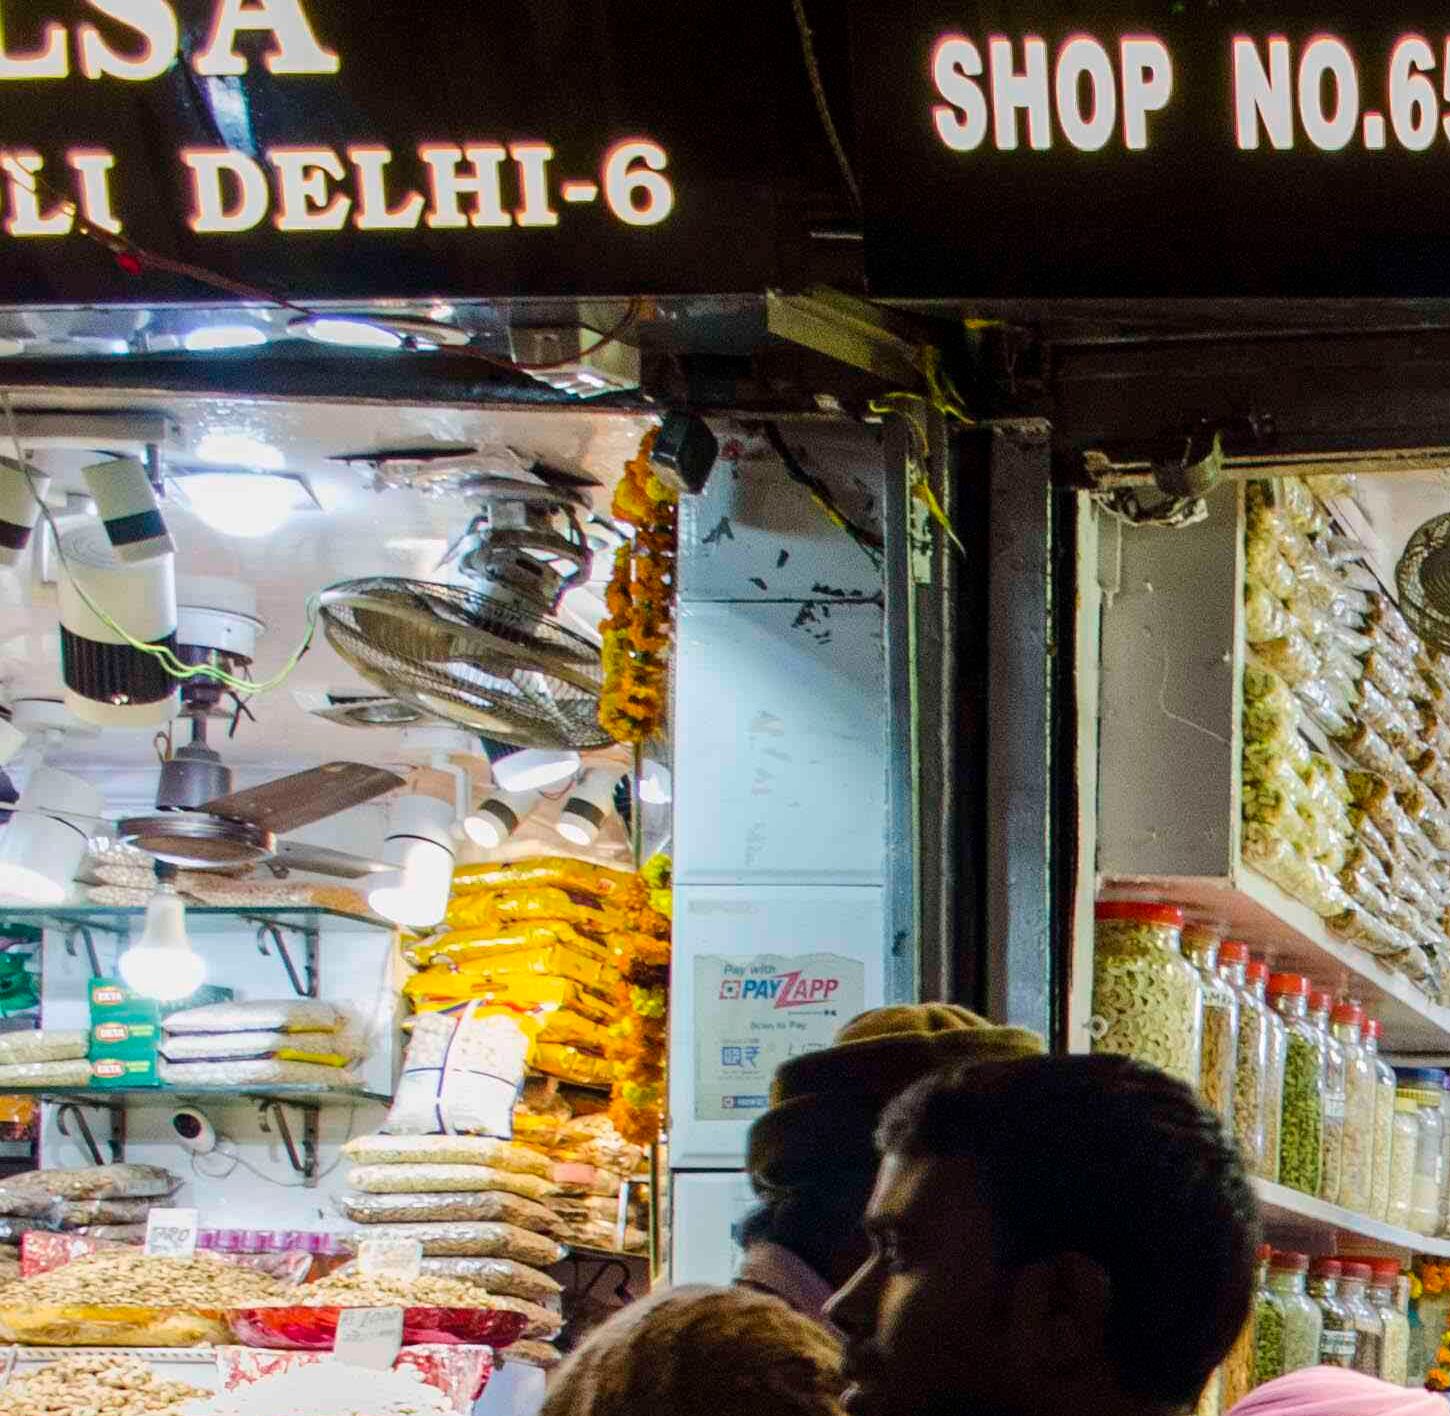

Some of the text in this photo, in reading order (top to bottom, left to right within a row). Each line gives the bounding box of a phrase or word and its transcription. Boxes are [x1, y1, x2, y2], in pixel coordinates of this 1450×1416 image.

[931, 34, 1173, 151] SHOP
[182, 142, 672, 232] DELHI-6
[742, 970, 839, 1009] PAYZAPP
[750, 963, 776, 974] with
